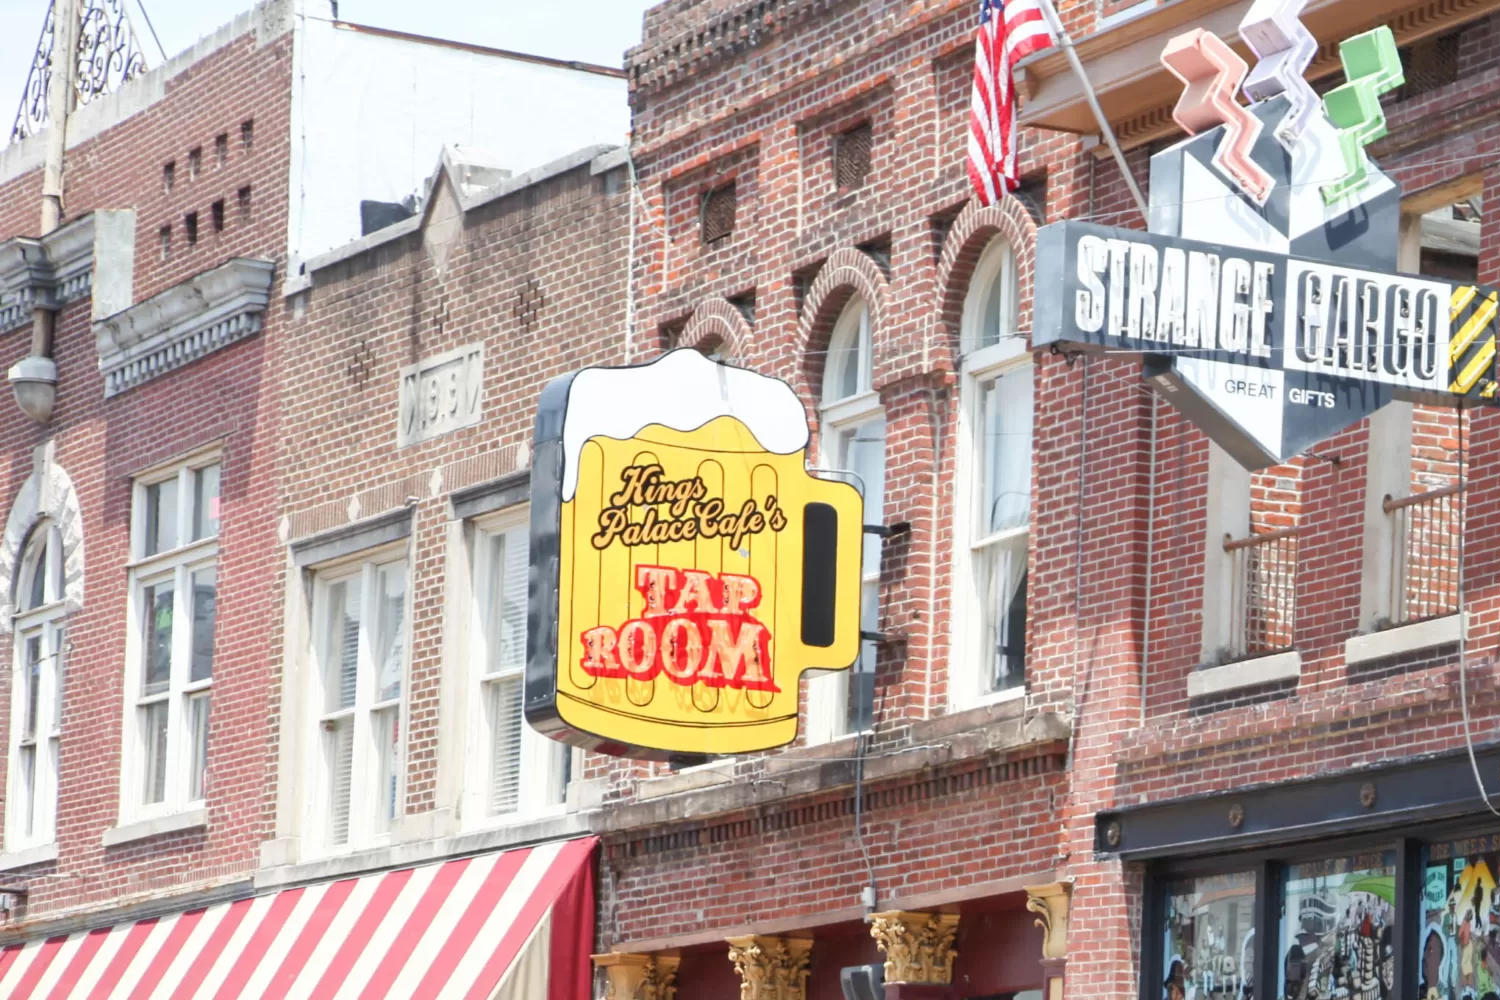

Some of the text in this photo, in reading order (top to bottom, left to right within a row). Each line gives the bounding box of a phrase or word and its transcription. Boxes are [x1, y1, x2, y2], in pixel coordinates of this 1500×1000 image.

[1075, 234, 1440, 380] STRANGE CARGO
[1224, 379, 1335, 408] GREAT GIFTS
[613, 464, 707, 516] Kings
[591, 495, 787, 551] Palace Cafe's
[635, 564, 761, 620] TAP
[580, 616, 778, 690] ROOM
